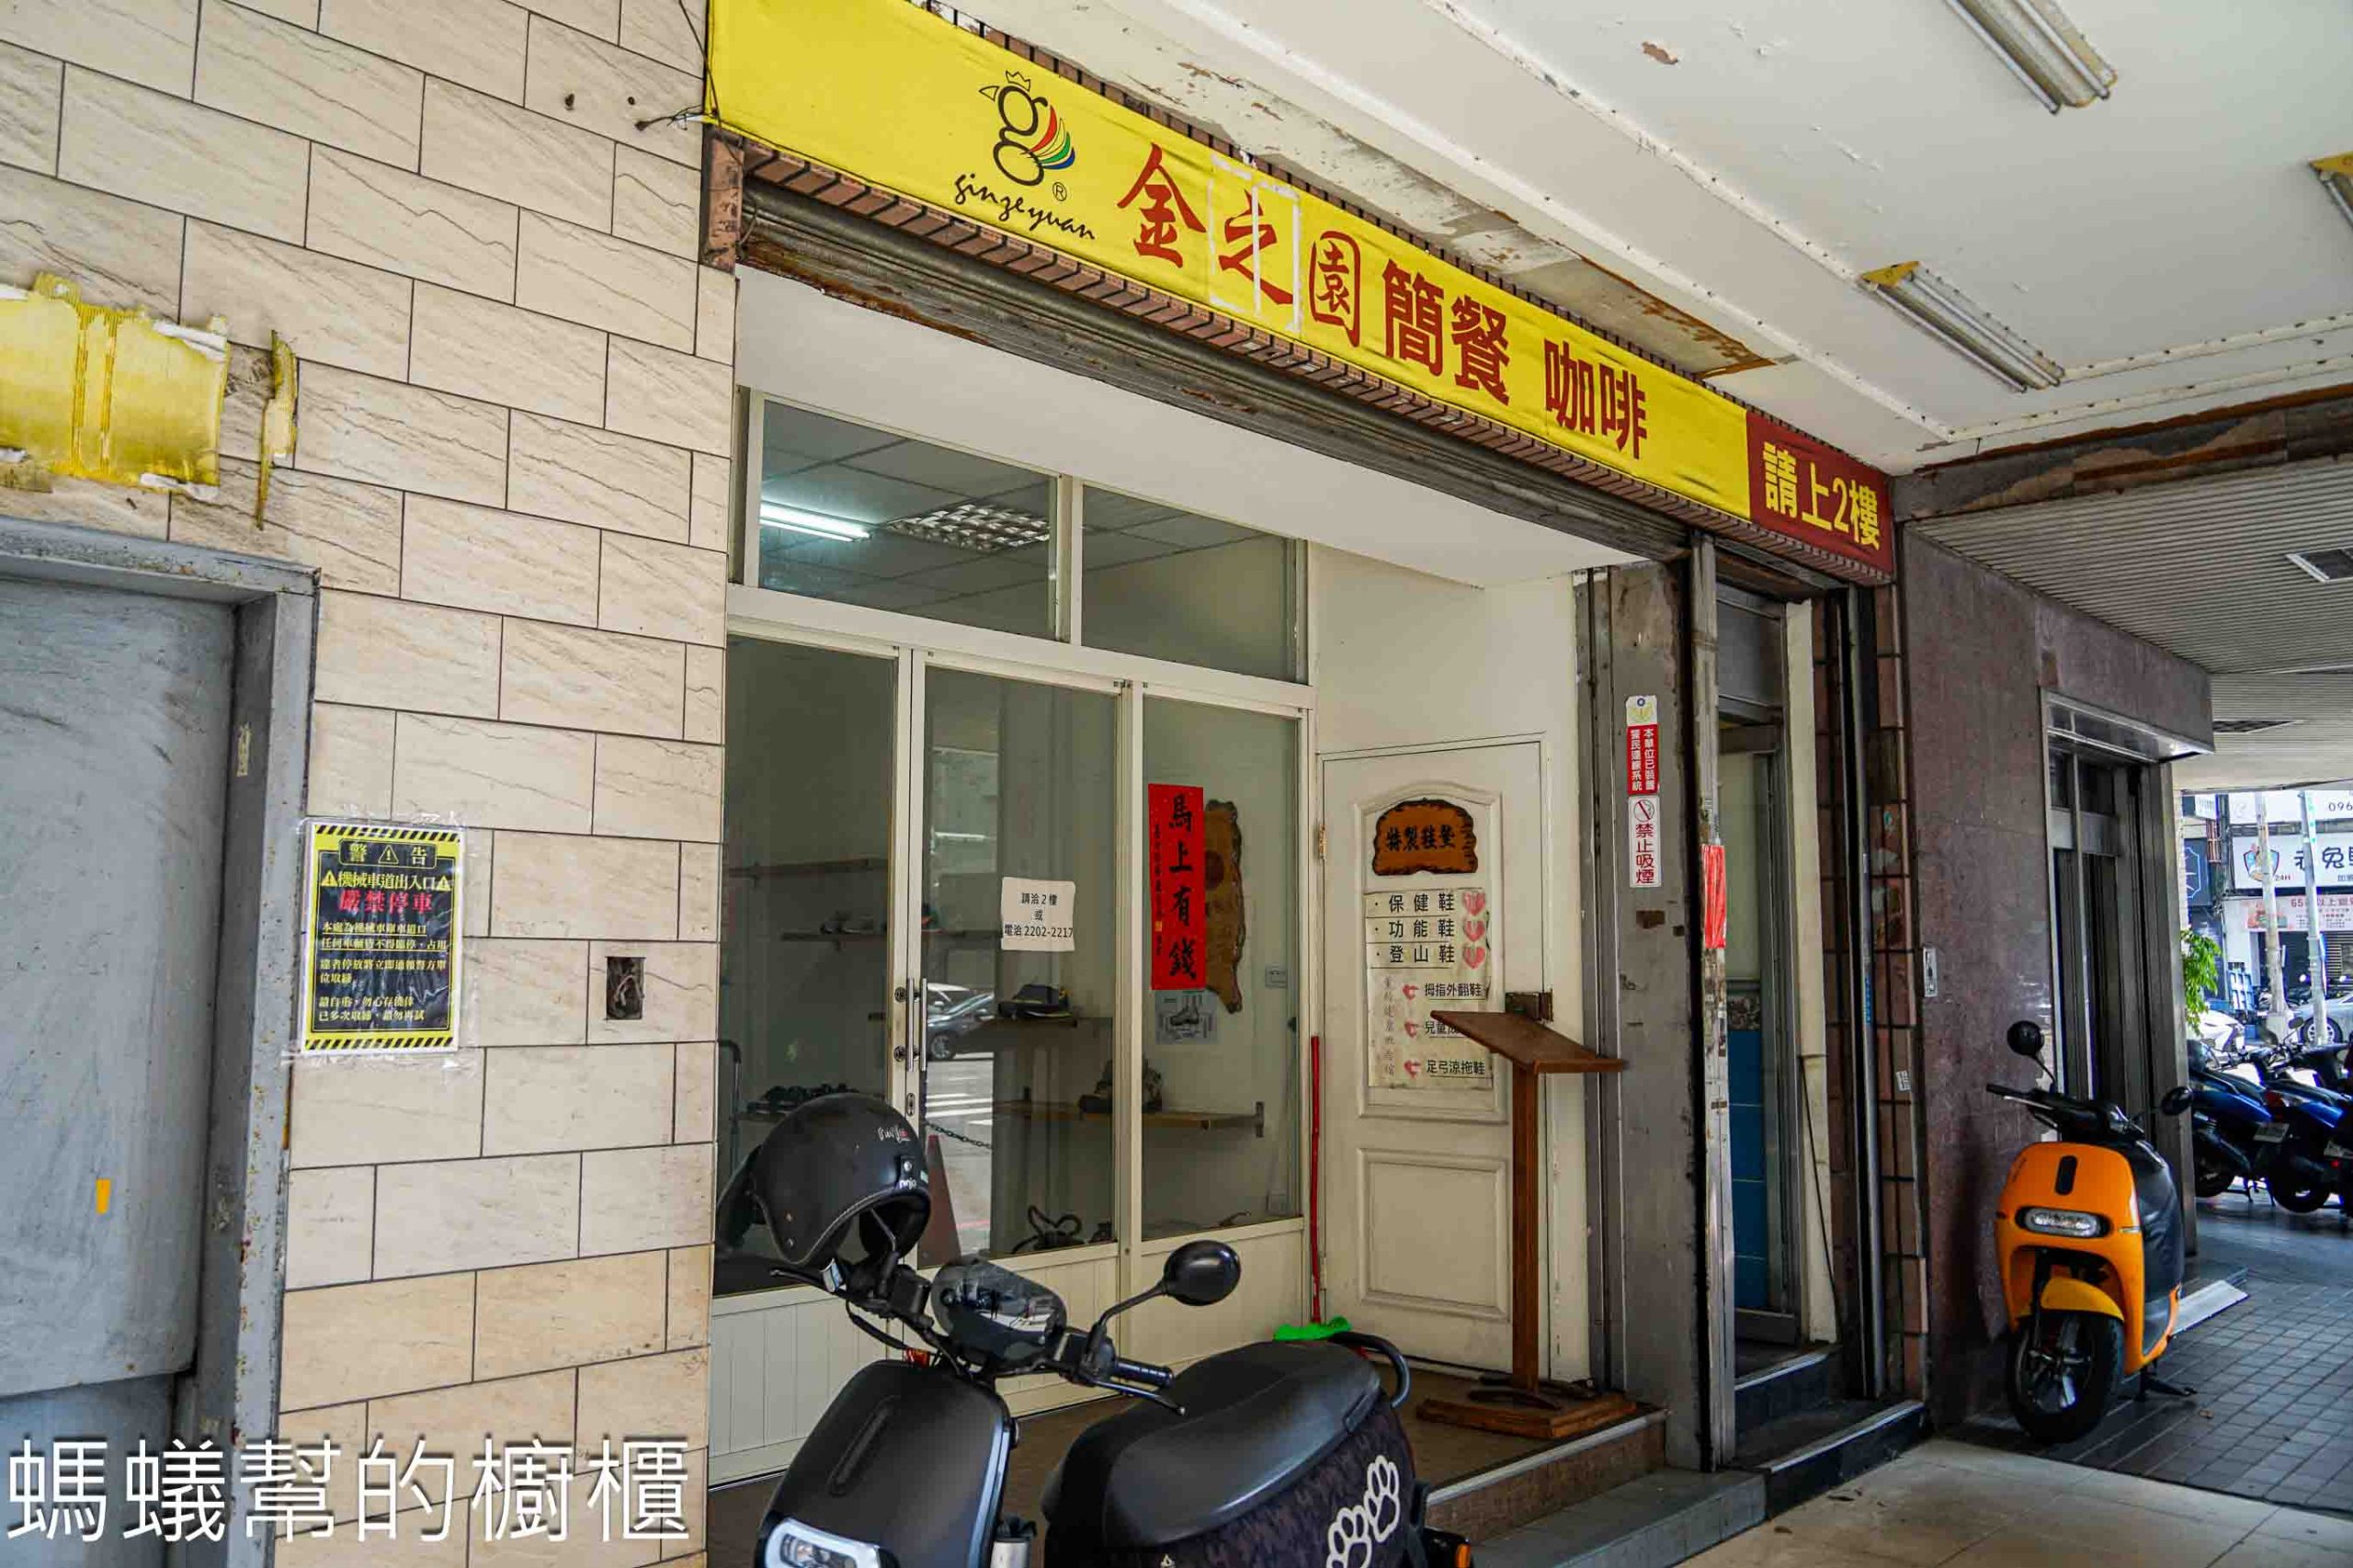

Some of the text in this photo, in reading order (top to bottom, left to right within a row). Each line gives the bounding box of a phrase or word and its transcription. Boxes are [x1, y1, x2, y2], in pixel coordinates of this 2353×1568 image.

[1117, 142, 1361, 347] 金之園
[1382, 258, 1510, 405] 簡餐
[1543, 339, 1648, 460] 咖啡
[1762, 441, 1881, 551] 請上2樓
[349, 843, 427, 866] 警告
[1635, 824, 1655, 884] 禁止吸煙
[337, 870, 437, 892] 機械車道出入口
[1168, 793, 1196, 980] 馬上有錢
[338, 889, 434, 915] 嚴禁停車
[1389, 893, 1455, 914] 保健鞋
[1034, 909, 1043, 922] 或
[1389, 918, 1455, 938] 功能鞋
[1389, 945, 1455, 964] 登山鞋
[1425, 983, 1483, 997] 拇指外翻鞋
[1427, 1059, 1485, 1075] 足弓涼拖鞋
